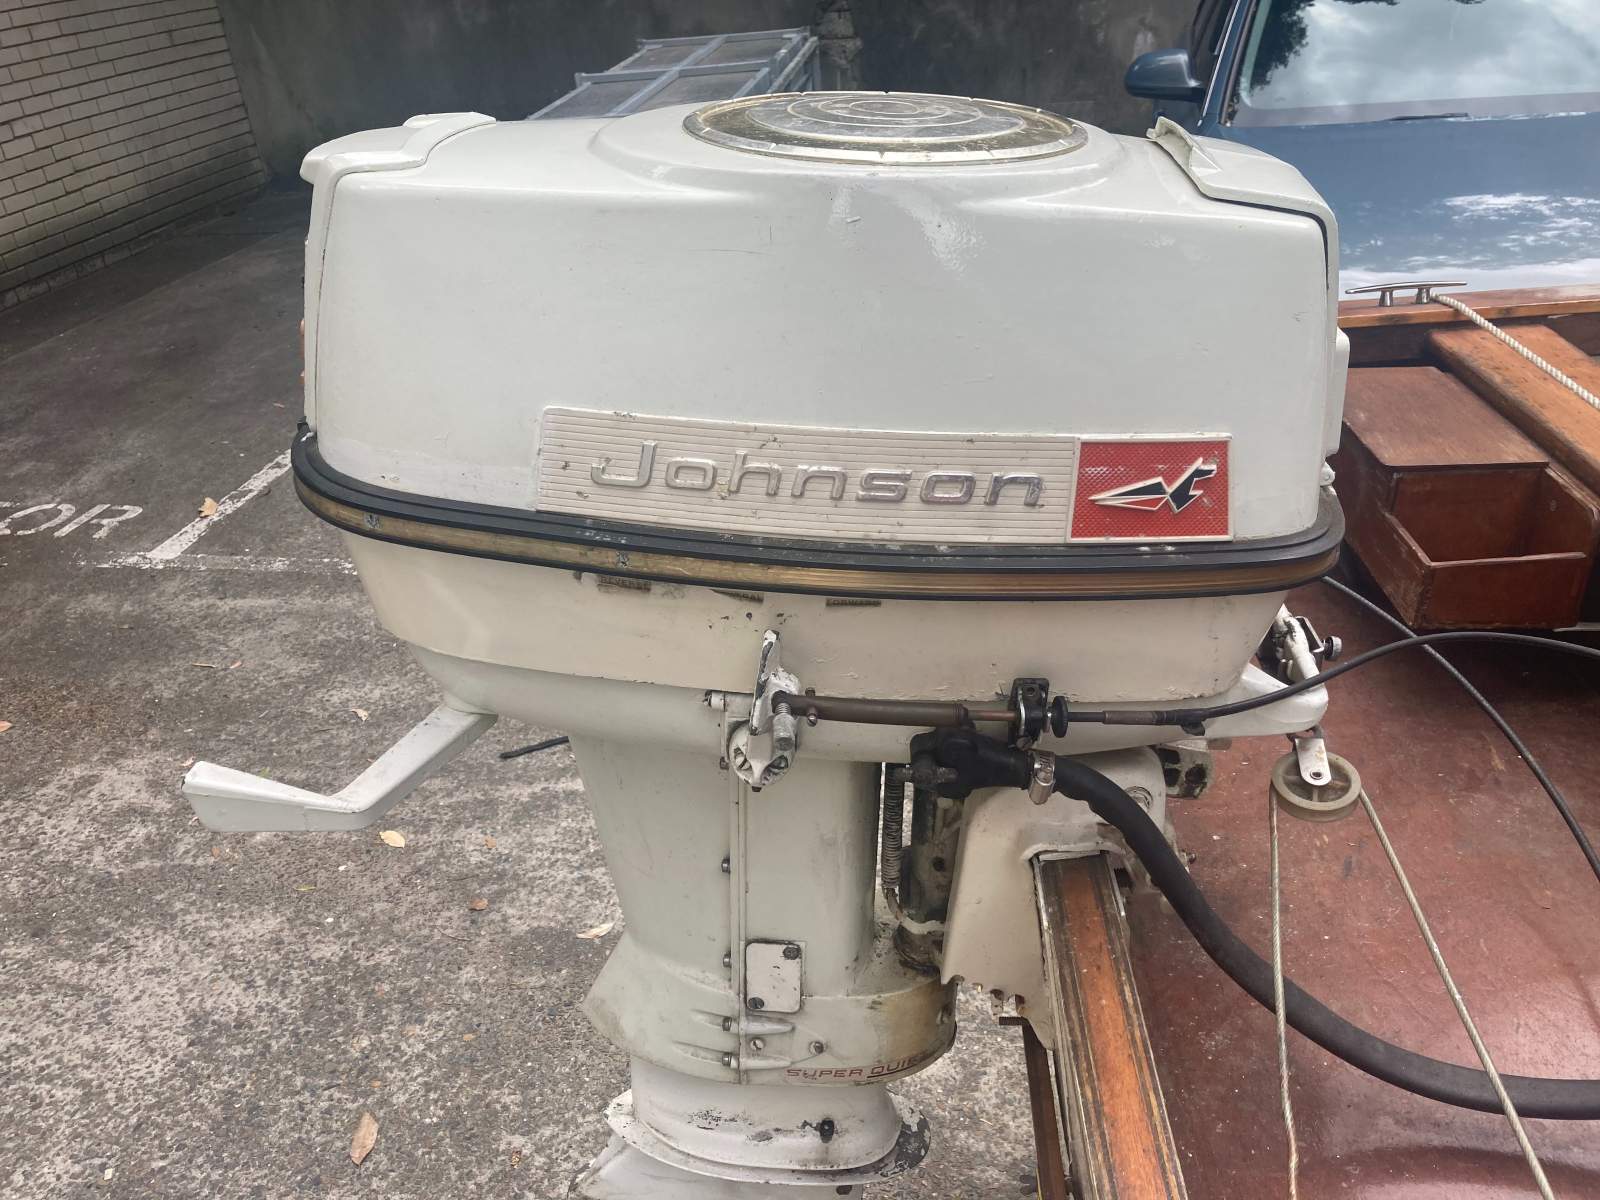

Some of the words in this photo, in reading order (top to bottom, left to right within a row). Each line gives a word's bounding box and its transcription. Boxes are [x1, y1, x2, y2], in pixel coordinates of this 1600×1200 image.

[590, 440, 1044, 507] Johnson
[787, 1068, 863, 1079] SUPER
[870, 1057, 922, 1075] QUIE
